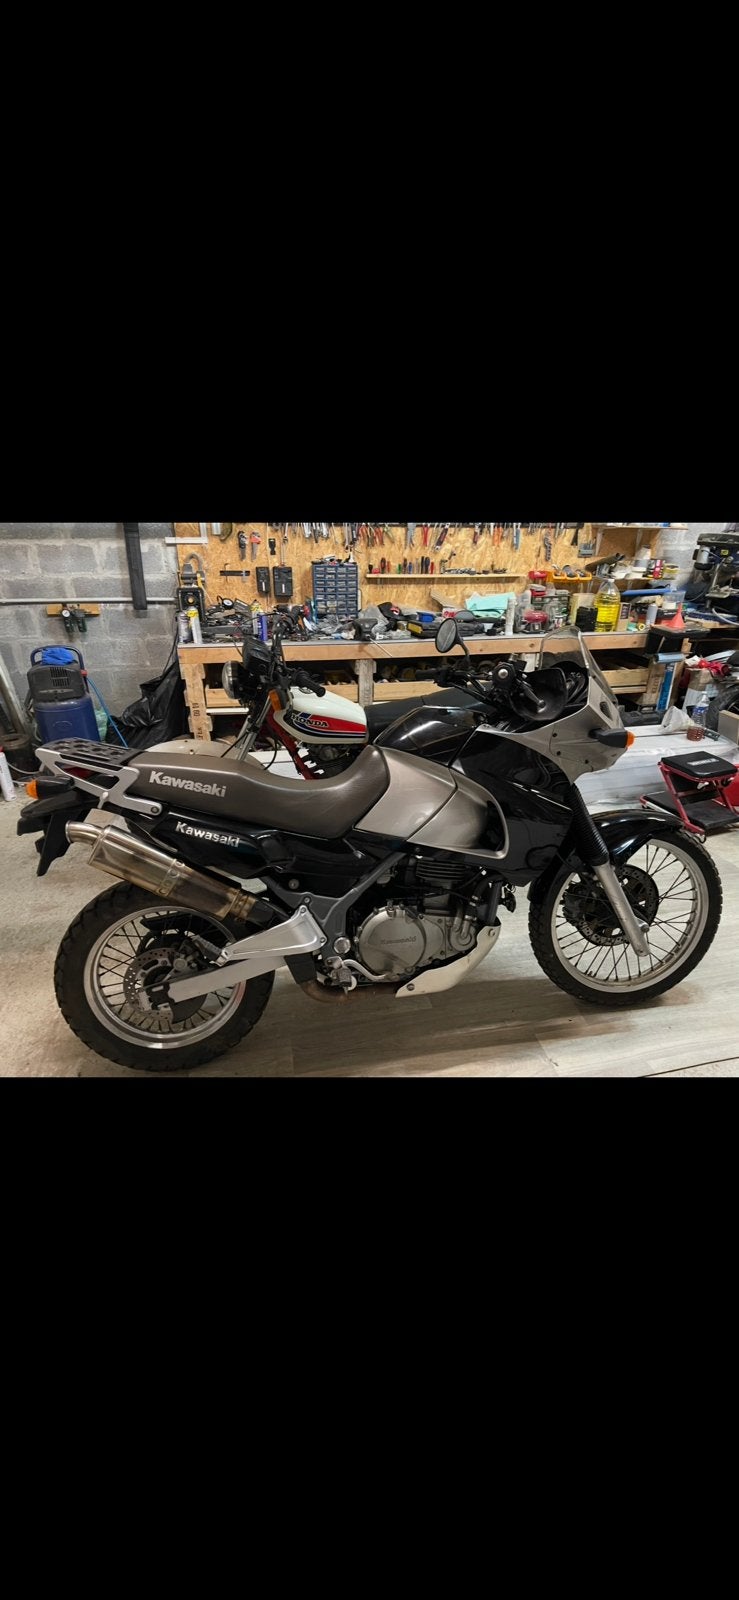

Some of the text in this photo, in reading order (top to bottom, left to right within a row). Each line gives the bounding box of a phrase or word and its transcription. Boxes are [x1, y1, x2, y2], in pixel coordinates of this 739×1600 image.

[291, 713, 329, 728] HONDA
[149, 770, 226, 797] Kawasaki
[175, 821, 240, 847] Kawasaki
